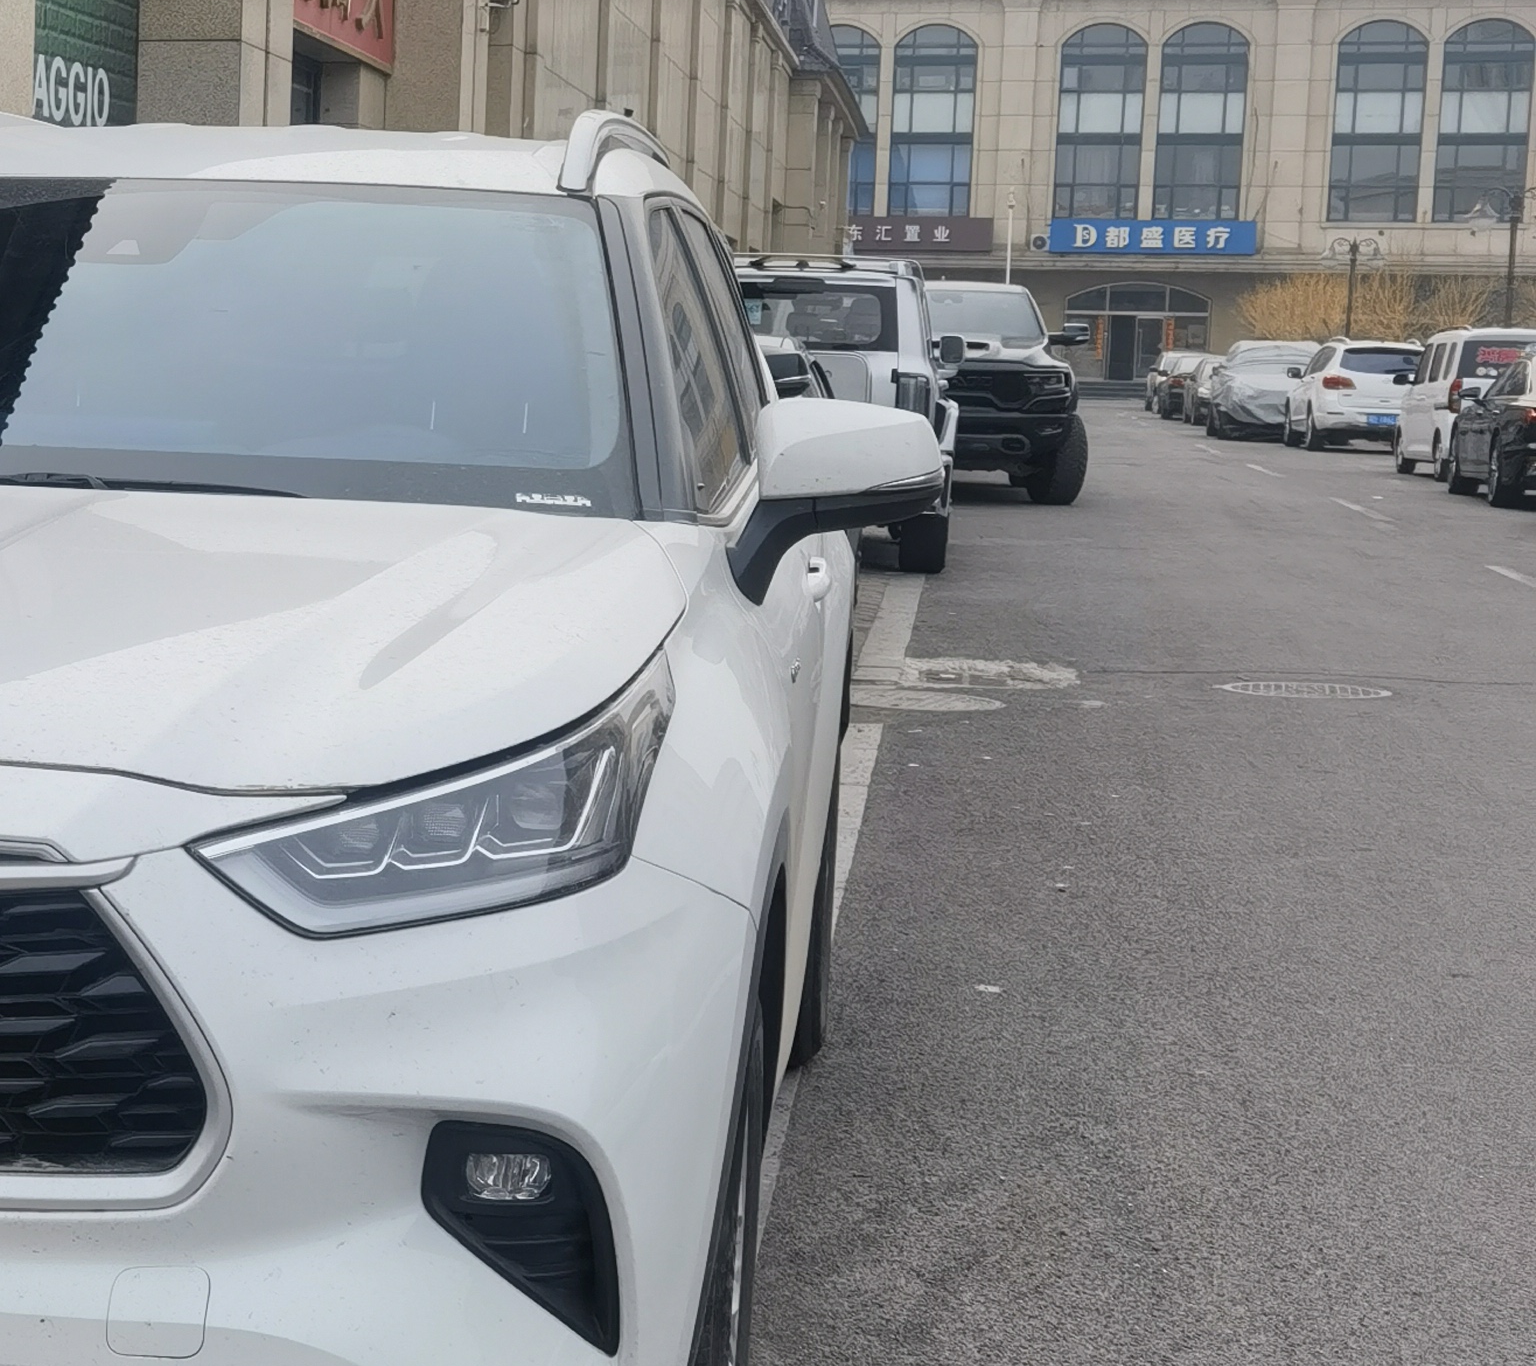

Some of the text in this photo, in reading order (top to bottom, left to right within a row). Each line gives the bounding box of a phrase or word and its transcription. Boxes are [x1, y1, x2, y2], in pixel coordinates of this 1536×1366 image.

[848, 224, 951, 242] 东汇置业
[1105, 225, 1231, 249] 都盛医疗
